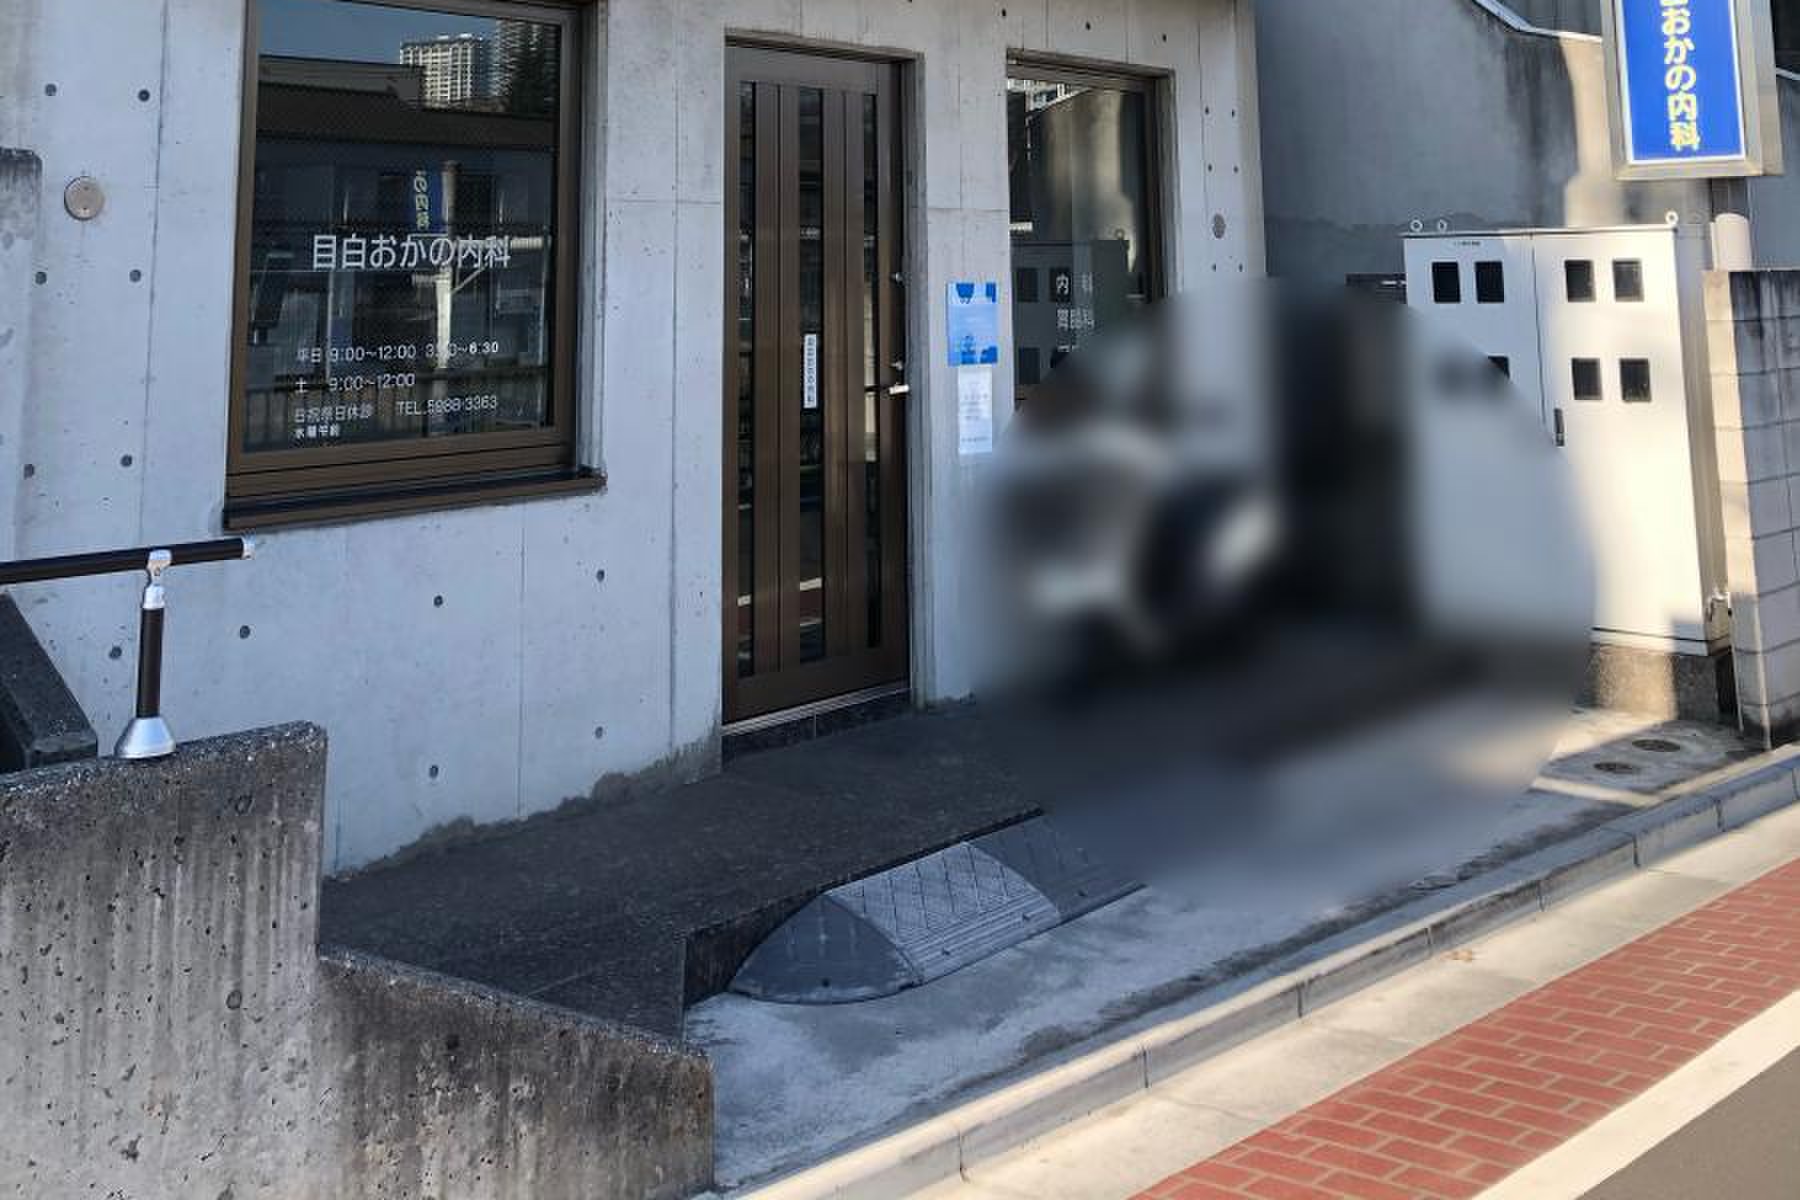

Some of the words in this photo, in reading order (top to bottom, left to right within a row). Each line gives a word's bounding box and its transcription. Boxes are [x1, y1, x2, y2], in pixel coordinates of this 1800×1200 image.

[312, 231, 512, 270] 目白おかの内科
